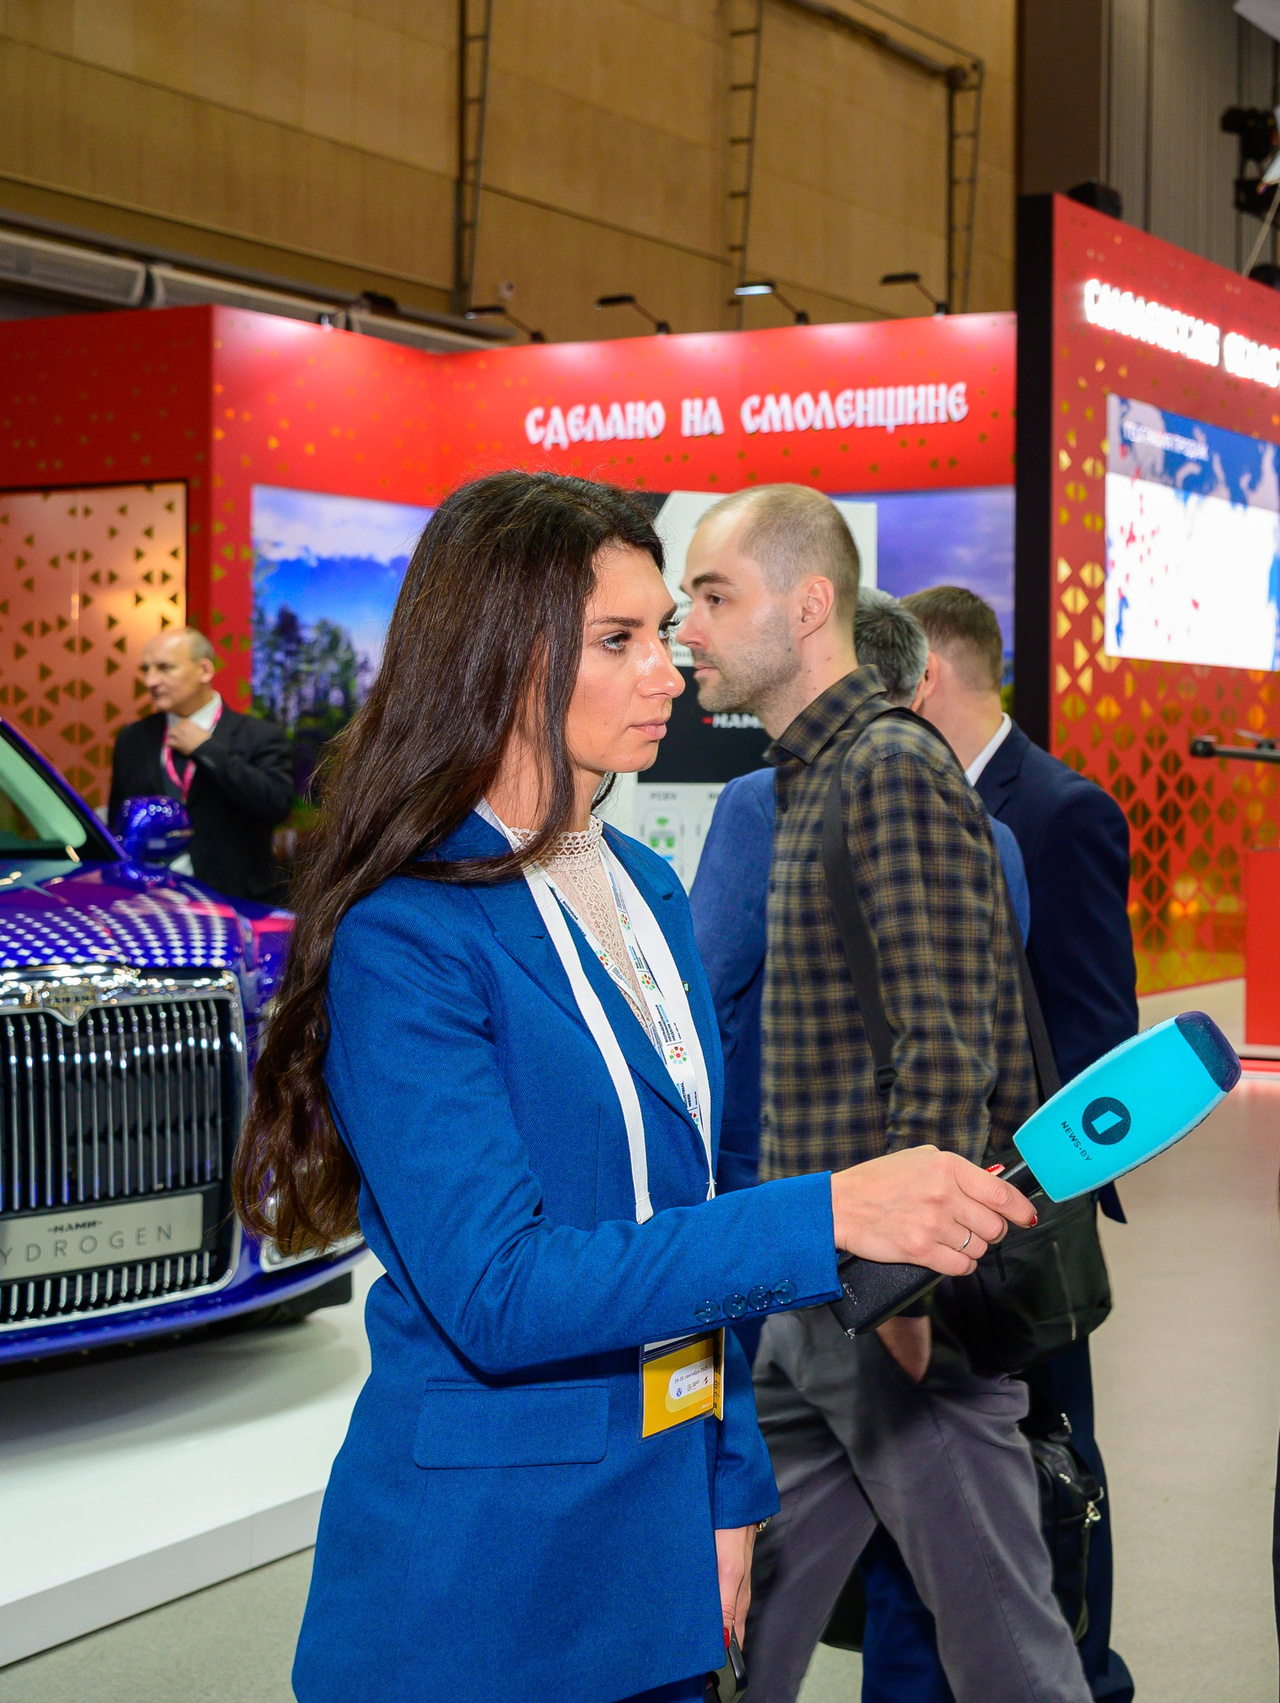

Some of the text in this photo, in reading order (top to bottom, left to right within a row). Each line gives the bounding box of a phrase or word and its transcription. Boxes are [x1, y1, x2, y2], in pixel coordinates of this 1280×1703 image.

[525, 382, 969, 451] СДЕЛАНО НА СМОЛЕНЩИНЕ
